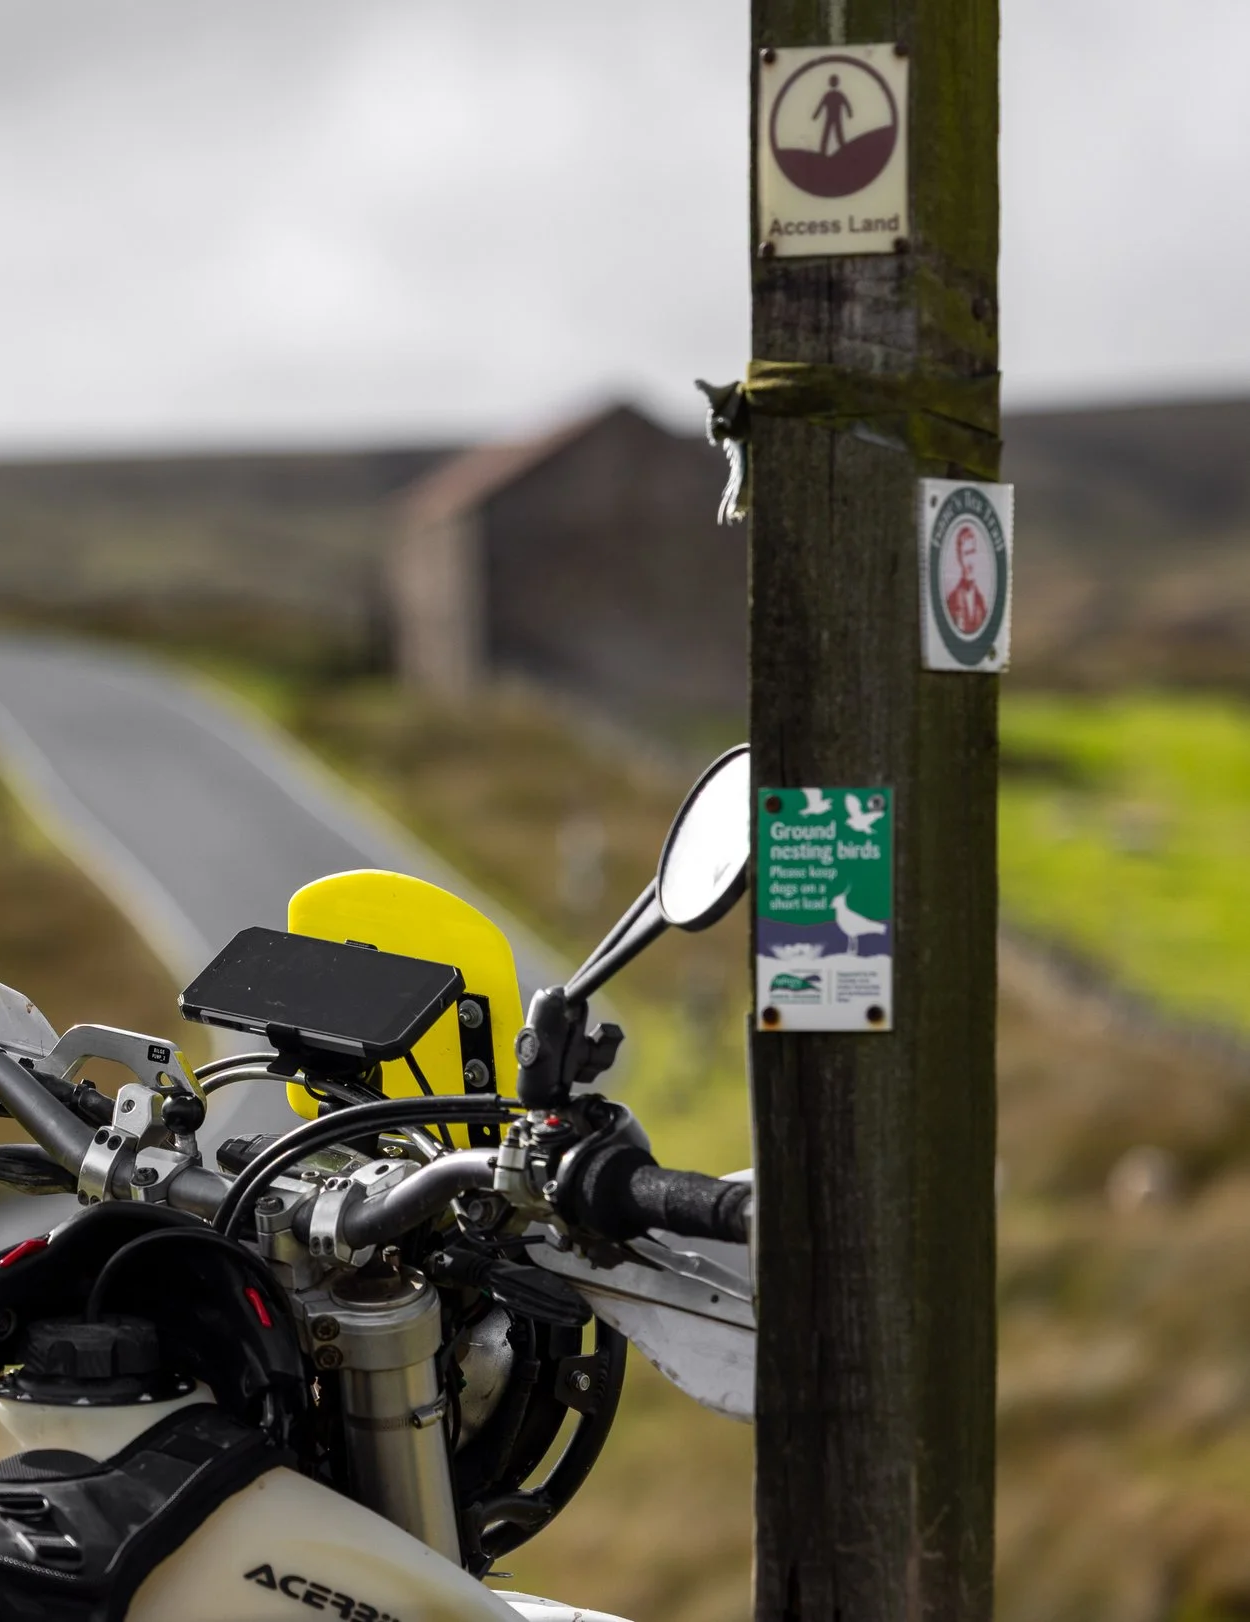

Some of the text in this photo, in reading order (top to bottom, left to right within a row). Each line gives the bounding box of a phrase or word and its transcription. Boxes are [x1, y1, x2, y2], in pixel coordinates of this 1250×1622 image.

[769, 214, 900, 236] Access Land
[770, 820, 836, 840] Ground
[770, 840, 881, 865] nesting birds
[769, 865, 838, 881] Please keep
[769, 881, 827, 898] dogs on a
[769, 897, 827, 910] short lead
[243, 1563, 401, 1622] ACERB
